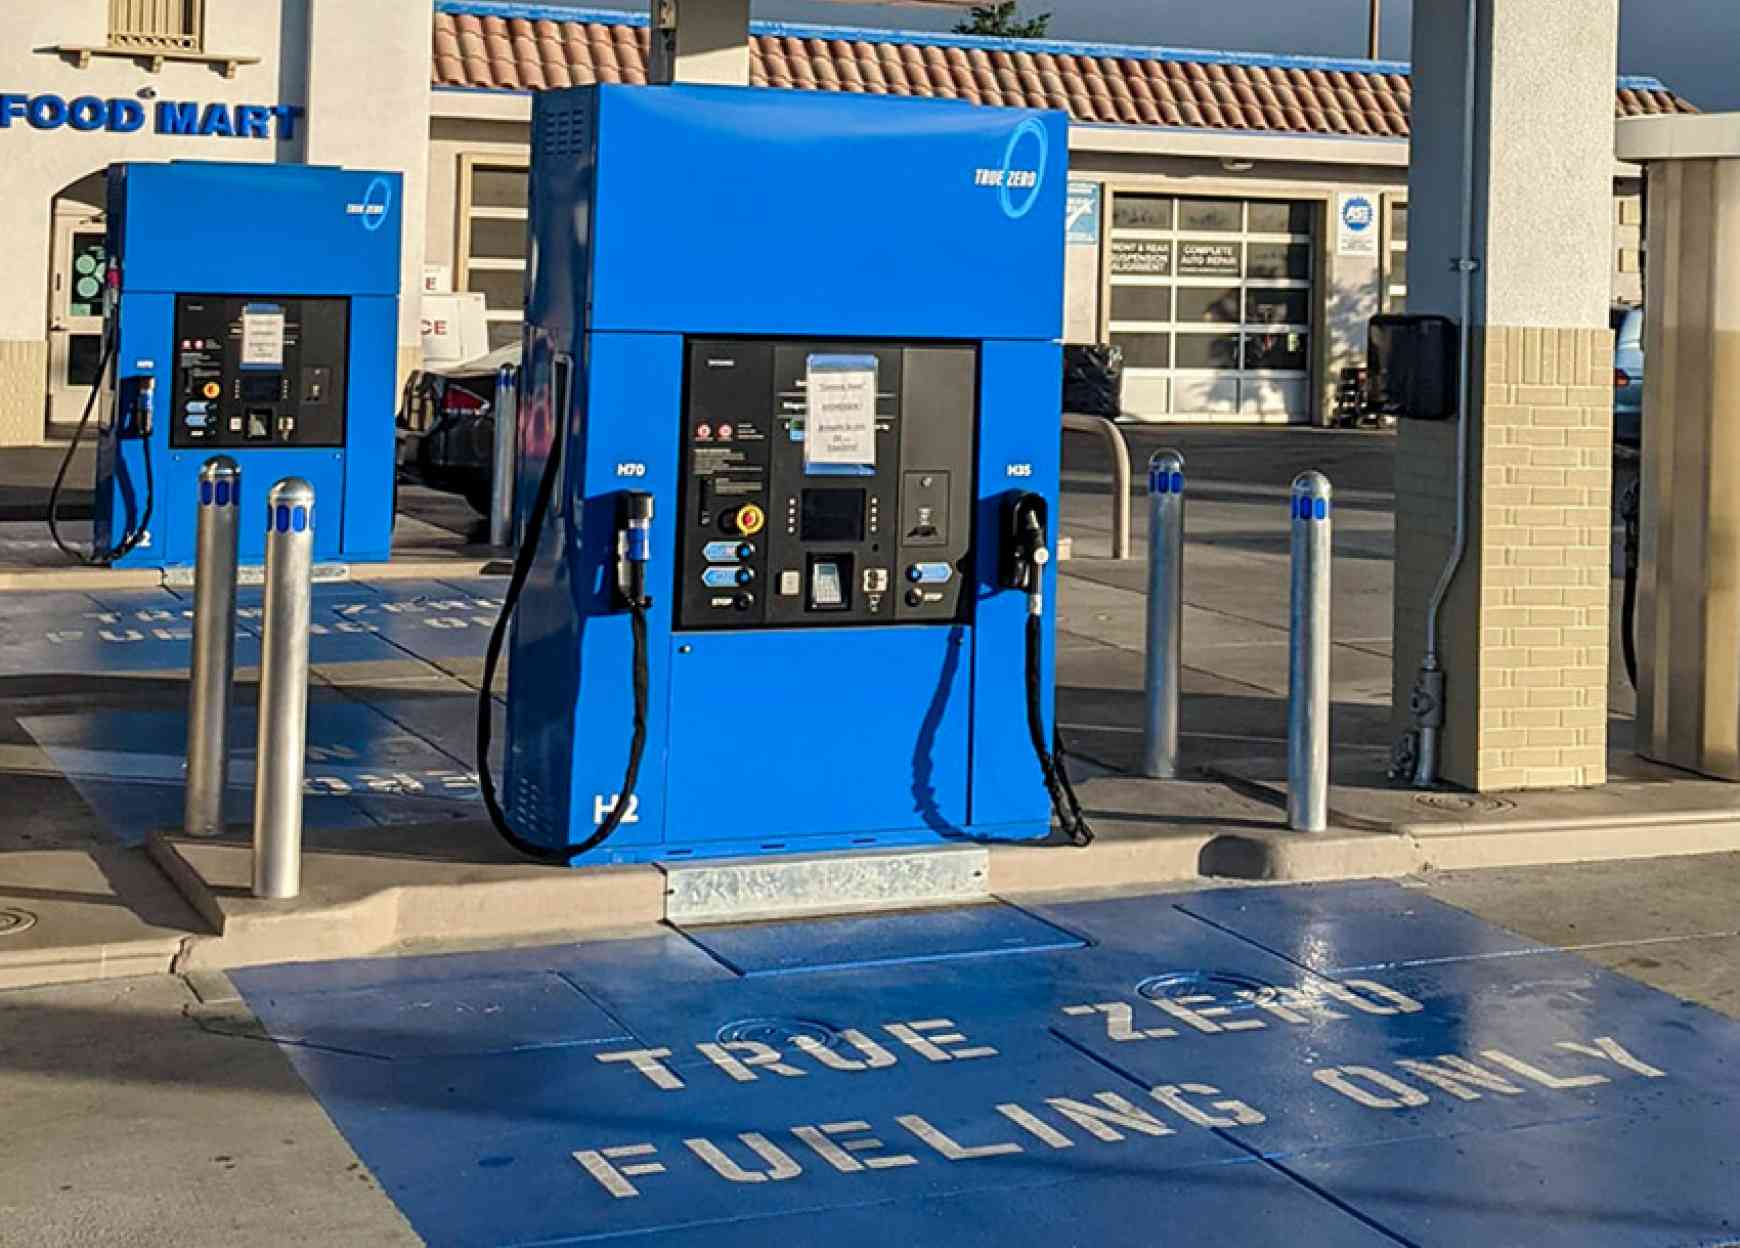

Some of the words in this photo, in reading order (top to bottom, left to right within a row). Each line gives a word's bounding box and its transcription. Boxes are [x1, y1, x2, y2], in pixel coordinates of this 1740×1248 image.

[0, 94, 145, 133] FOOD
[154, 101, 305, 140] MART
[594, 793, 640, 824] H2
[595, 1018, 999, 1091] TRUE
[1062, 978, 1424, 1042] ZERO
[572, 1082, 1267, 1198] FUELING
[1312, 1037, 1668, 1110] ONLY
